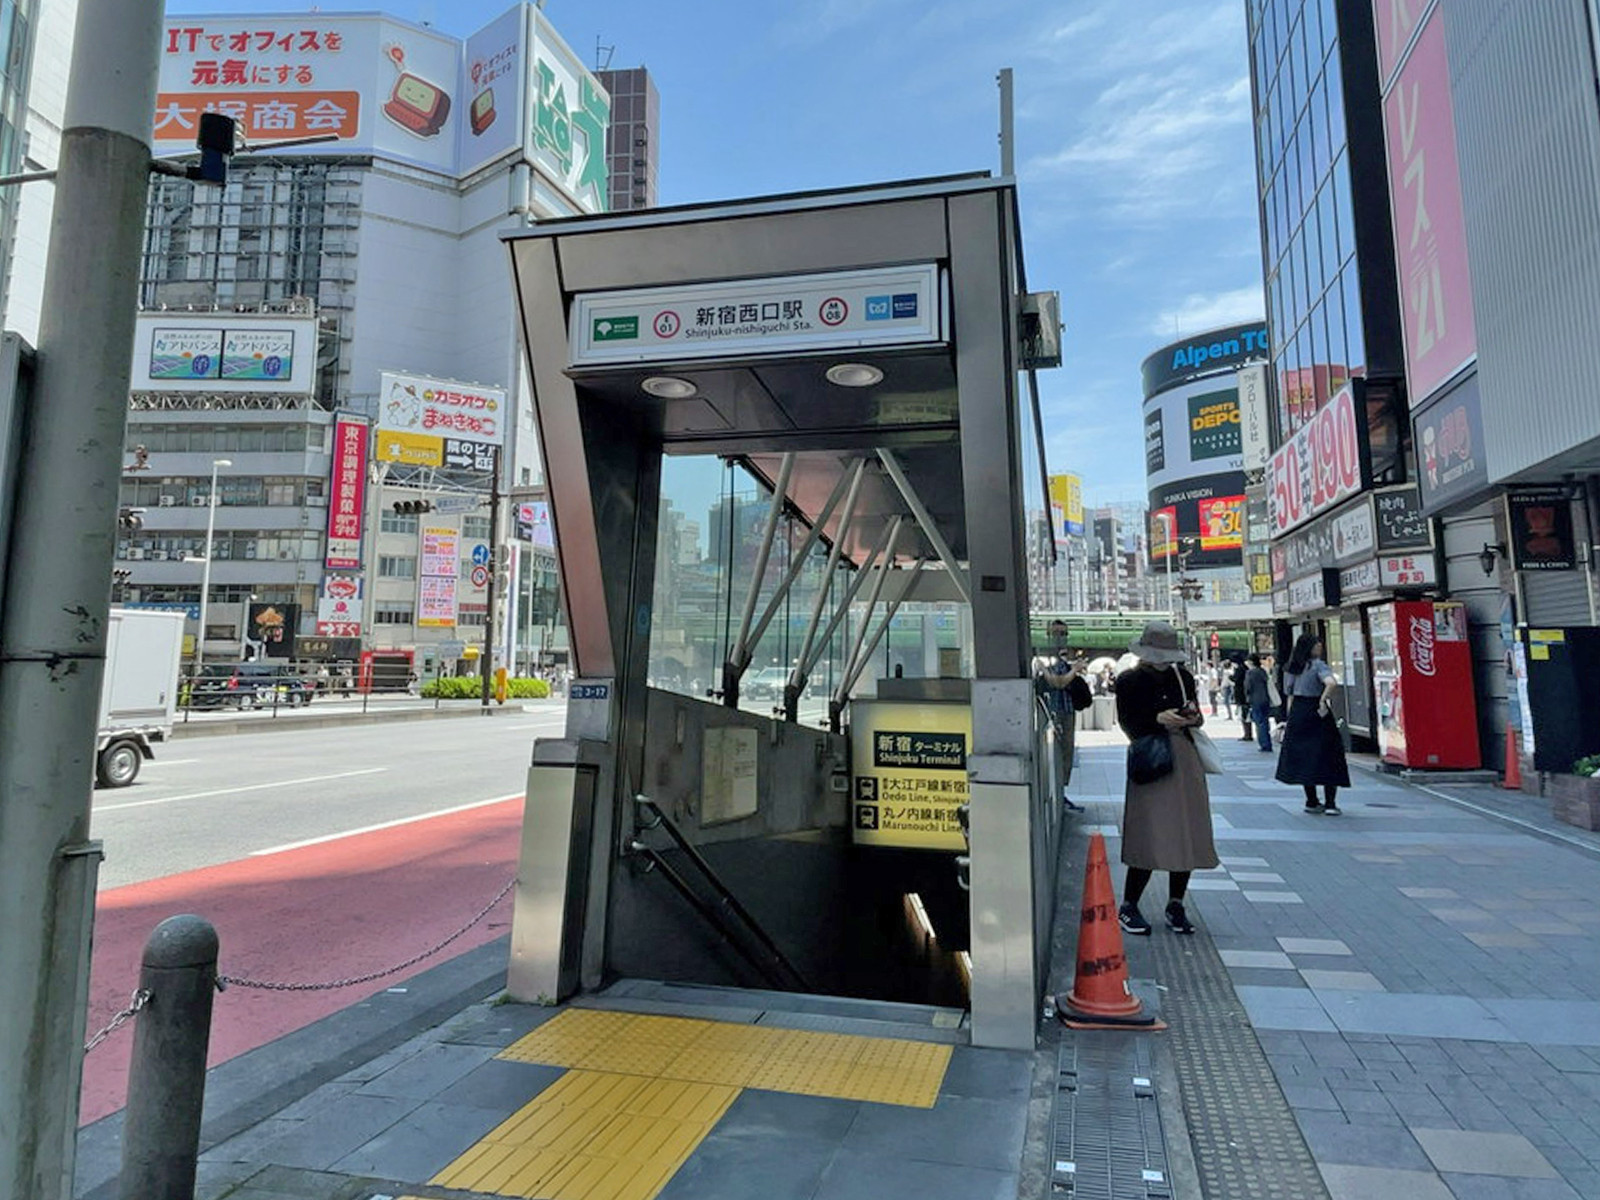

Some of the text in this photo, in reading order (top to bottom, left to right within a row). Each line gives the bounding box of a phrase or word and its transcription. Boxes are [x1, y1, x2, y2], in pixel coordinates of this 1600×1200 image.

[166, 28, 342, 53] ITでオフィスを
[191, 59, 312, 86] 元気にする
[696, 300, 803, 326] 新宿西口駅
[826, 311, 841, 320] 08
[659, 323, 672, 333] 01
[685, 321, 814, 339] Shinjuku-nishiguchi Sta.
[168, 341, 220, 351] アドバンス
[240, 342, 290, 352] アドバンス
[1172, 339, 1240, 370] Alpen
[434, 390, 487, 409] カラオケ
[422, 407, 496, 436] まねきねこ
[1192, 410, 1242, 431] DEPO
[1307, 390, 1357, 508] 190
[1186, 488, 1213, 500] VISION
[1274, 443, 1300, 529] 50
[1383, 510, 1419, 526] しゃぶ
[1391, 523, 1427, 538] しゃぶ
[879, 735, 961, 752] 新宿 ターミナル
[880, 752, 961, 765] Shinjuku Terminal
[889, 778, 970, 794] 大江戸線新宿
[882, 791, 907, 801] Oedo
[882, 820, 940, 832] Marunouchi
